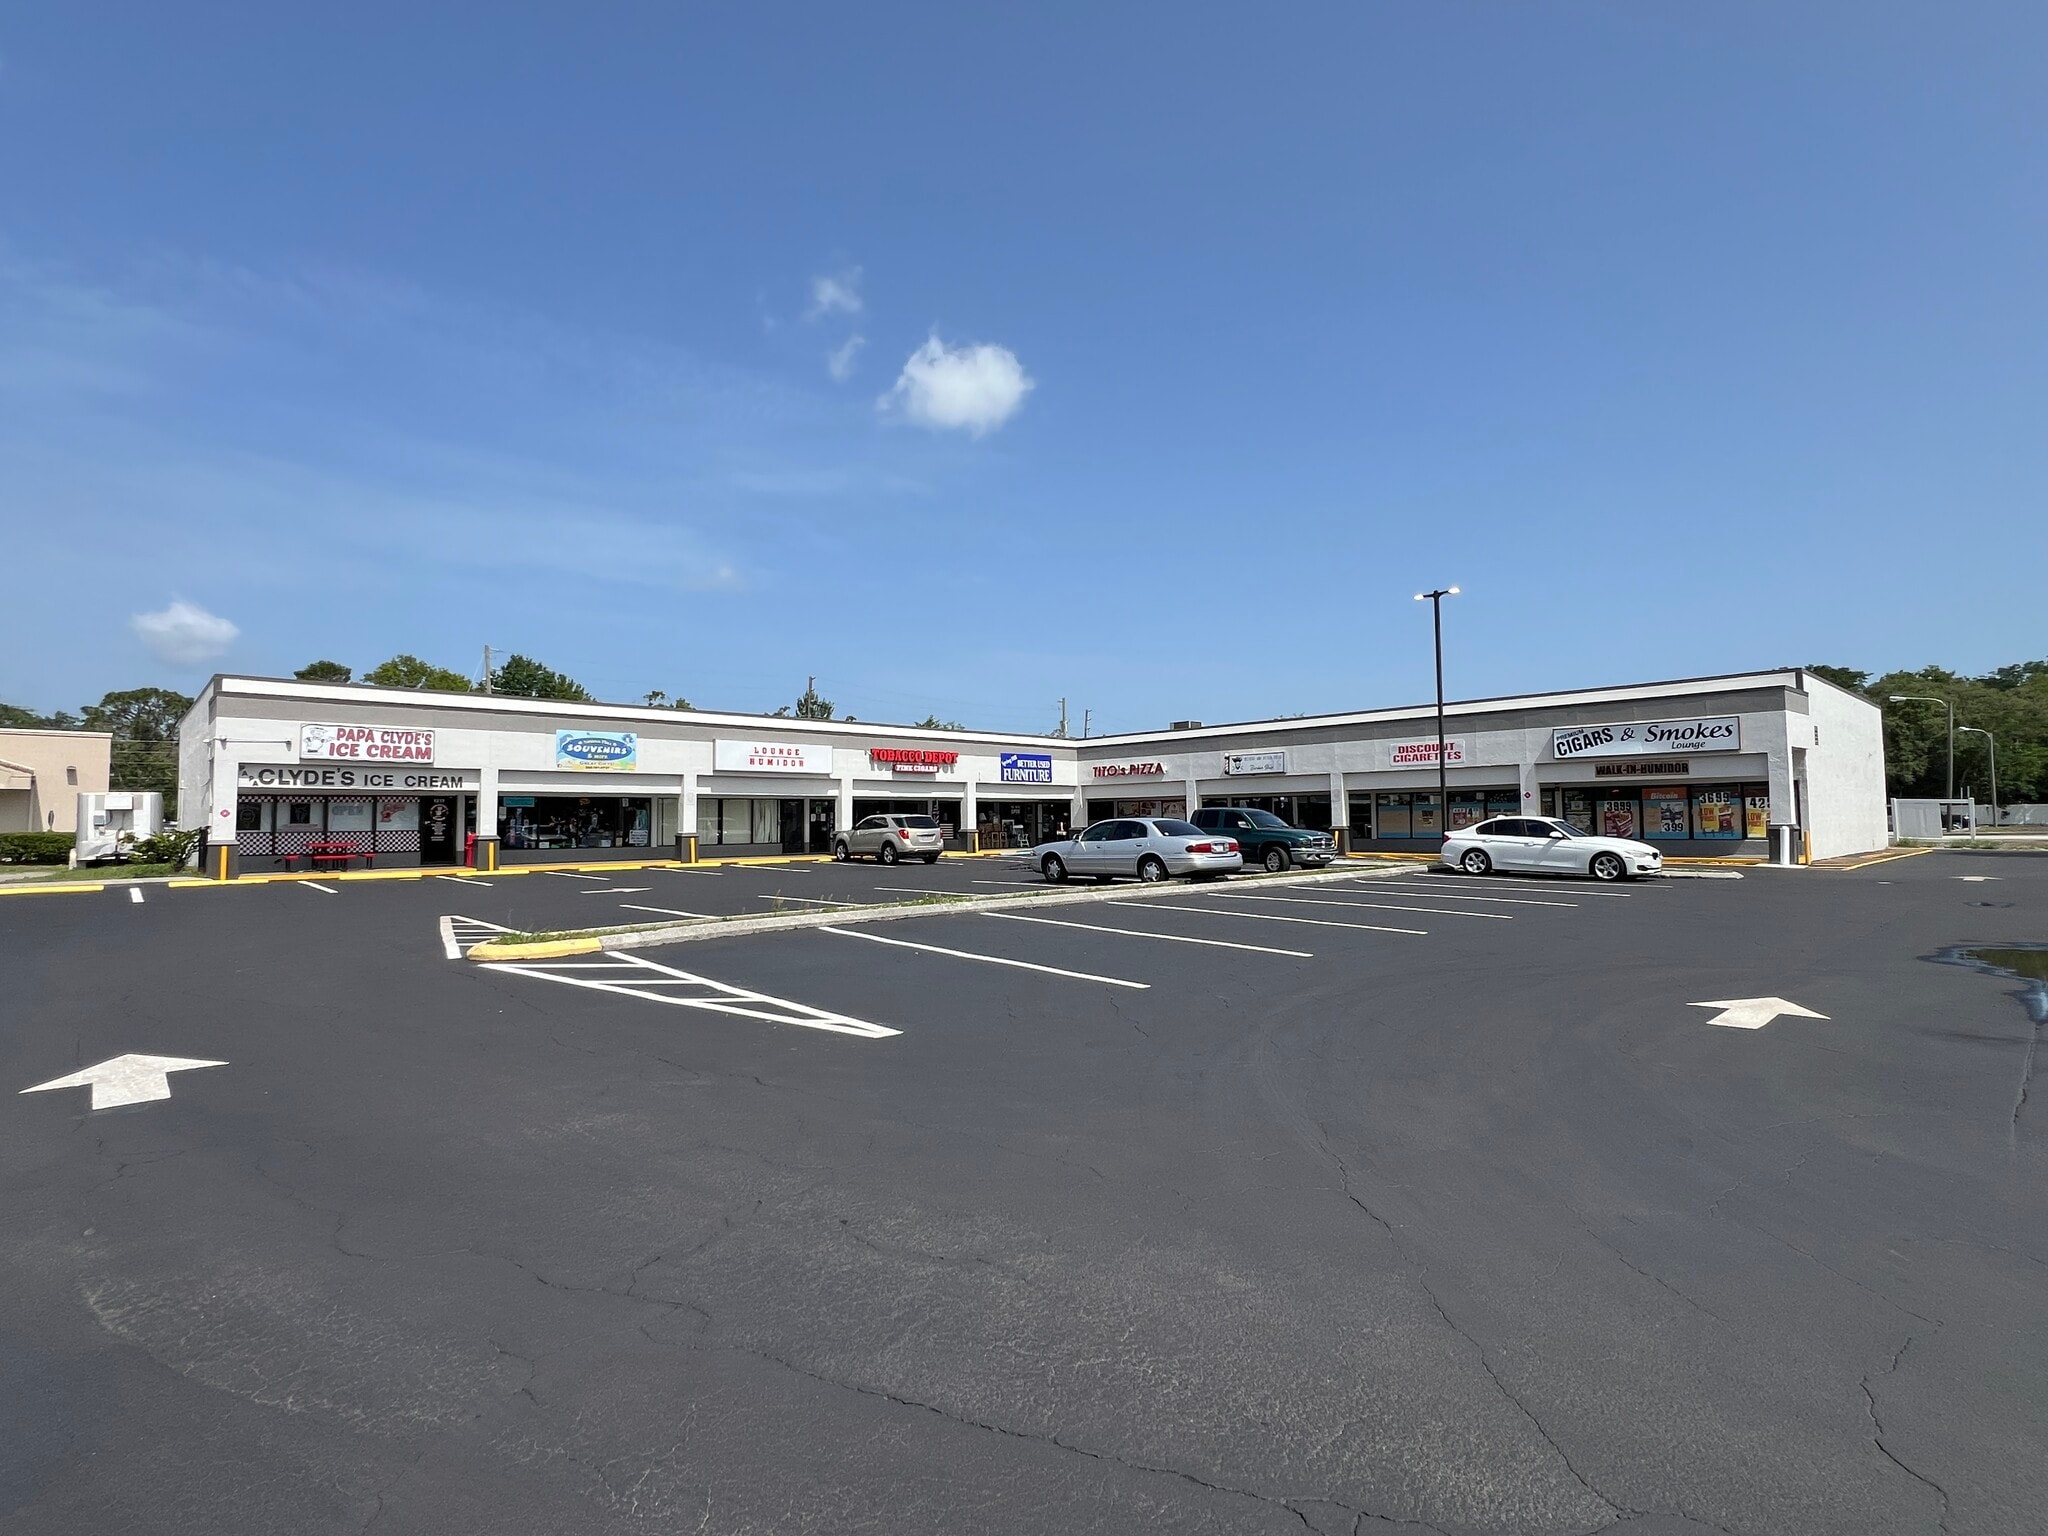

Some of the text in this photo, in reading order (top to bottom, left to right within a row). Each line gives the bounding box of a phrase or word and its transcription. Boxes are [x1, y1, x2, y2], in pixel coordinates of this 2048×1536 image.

[336, 728, 432, 746] PAPA CLYDE'S
[1556, 729, 1585, 741] PREMIUM
[1556, 722, 1734, 756] CIGARS & Smokes
[328, 742, 432, 760] ICE CREAM
[566, 744, 627, 755] SOUVENIRS
[754, 746, 800, 756] LOUNGE
[1671, 741, 1706, 750] Lounge
[749, 757, 804, 767] HUMIDOR
[870, 748, 959, 764] TOBACCO DEPOT
[1393, 751, 1462, 763] CIGARETES
[913, 765, 938, 773] CIGARS
[1017, 759, 1037, 768] BETTER
[1037, 760, 1051, 769] USED
[1595, 762, 1690, 776] WALK-IN-HUMIDOR
[1003, 768, 1051, 782] FURNITURE
[1092, 763, 1165, 778] TITO's PIZZA
[258, 767, 355, 787] CLYDE'S
[364, 774, 394, 787] ICE
[404, 775, 463, 789] CREAM
[1650, 792, 1679, 800] Bitcoin
[1700, 792, 1730, 804] 3699
[1606, 801, 1632, 812] 3999
[1664, 822, 1684, 832] 399
